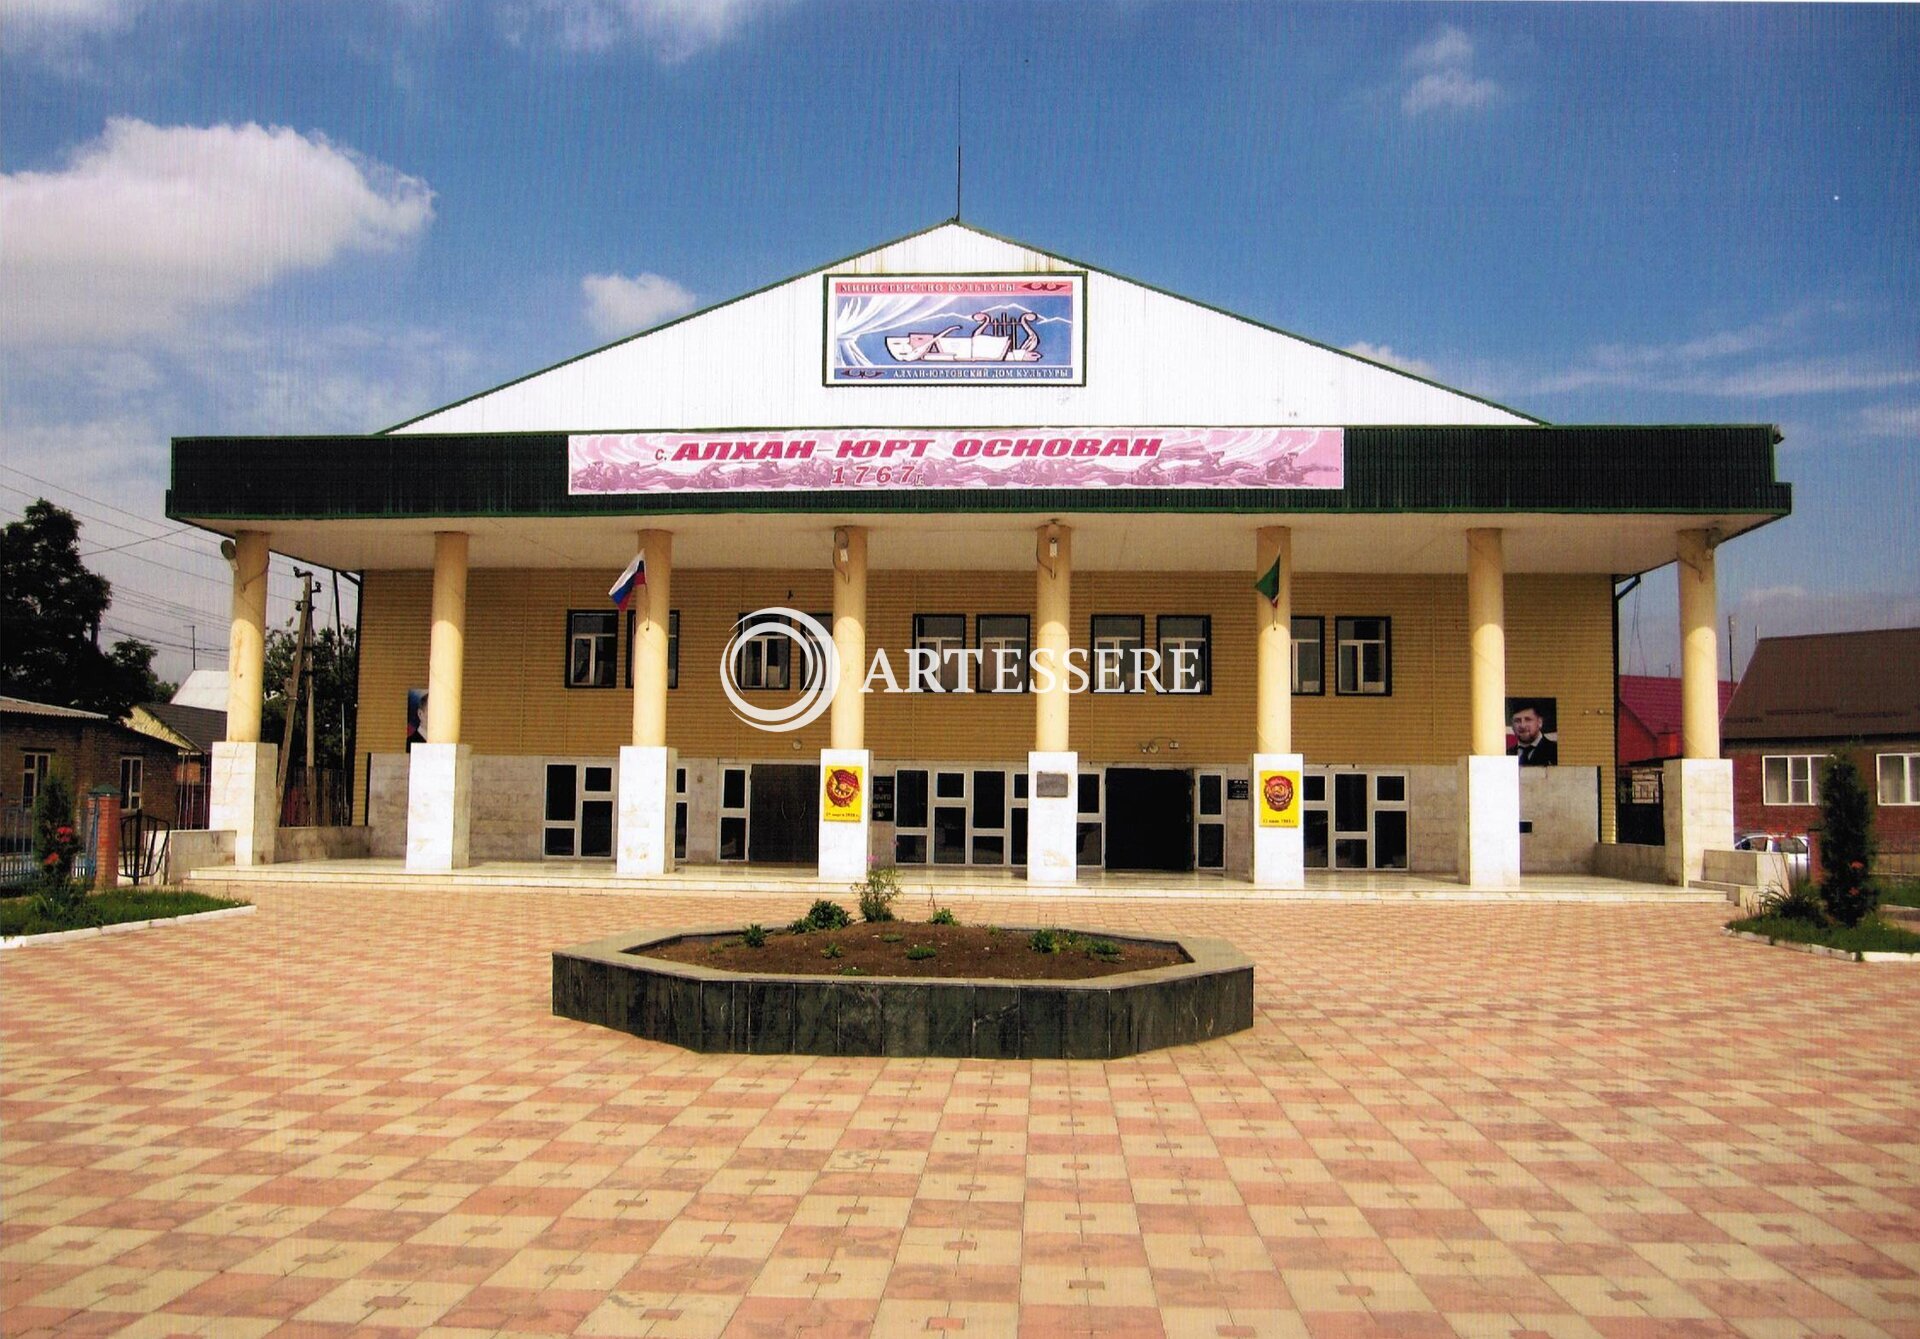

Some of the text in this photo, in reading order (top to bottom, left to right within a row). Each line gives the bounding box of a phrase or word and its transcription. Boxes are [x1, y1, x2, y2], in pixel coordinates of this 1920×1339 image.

[840, 283, 1016, 293] МИНИСТЕРСТВО КУЛЬТУРЫ
[893, 367, 1068, 378] АЛХАН-ЮРТОВСКИЙ ДОМ КУЛЬТУРЫ
[952, 438, 1163, 457] ОСНОВАН
[831, 466, 915, 484] 1767
